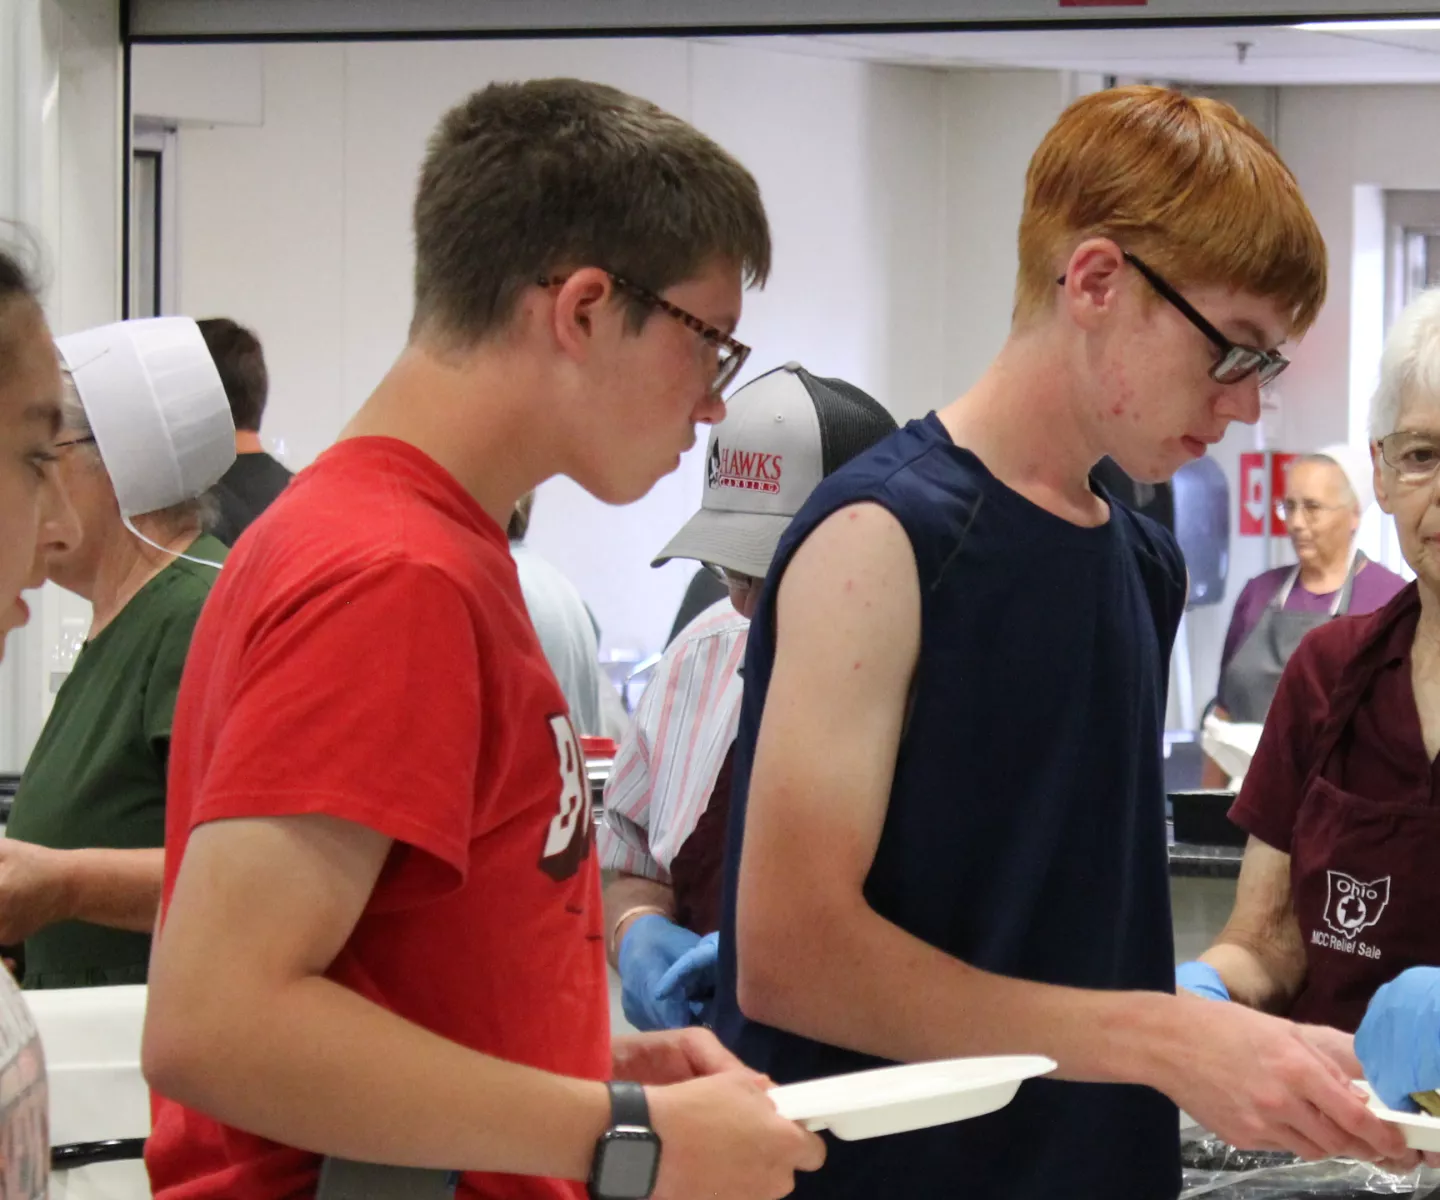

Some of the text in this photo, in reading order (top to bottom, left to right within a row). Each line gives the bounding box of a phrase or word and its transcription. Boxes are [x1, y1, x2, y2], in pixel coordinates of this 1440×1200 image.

[721, 447, 782, 480] HAWKS
[721, 477, 777, 493] LANDING
[1337, 880, 1378, 900] Ohio
[1310, 930, 1382, 960] MCC Relief Sale
